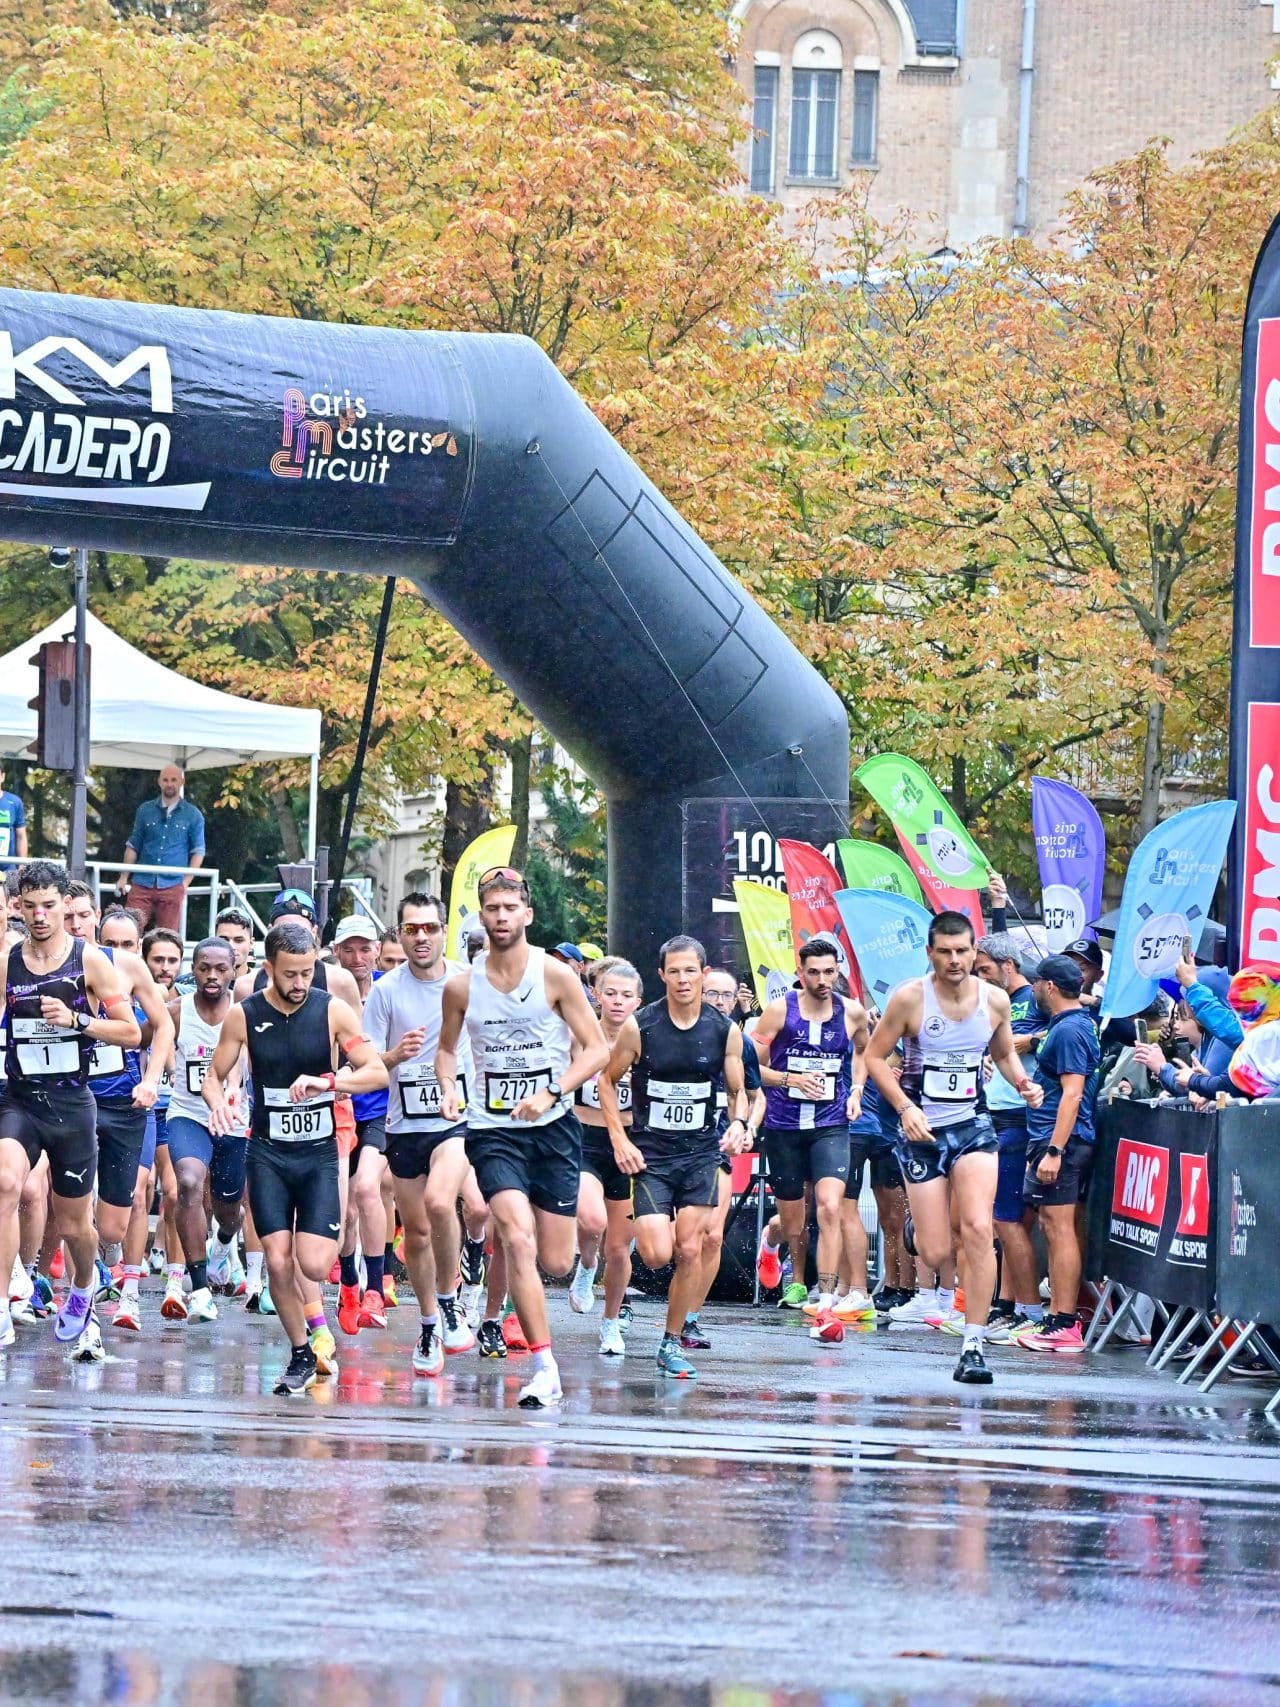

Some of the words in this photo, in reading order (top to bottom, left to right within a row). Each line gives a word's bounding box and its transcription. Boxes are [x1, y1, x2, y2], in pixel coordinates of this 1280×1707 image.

[43, 1046, 49, 1066] 1
[513, 1041, 543, 1051] LINES
[500, 1079, 537, 1100] 2727
[948, 1074, 958, 1091] 9
[420, 1086, 442, 1106] 44
[282, 1111, 321, 1134] 5087
[663, 1106, 694, 1123] 406
[1122, 1152, 1160, 1215] RMC
[1125, 1223, 1139, 1241] TALK
[1139, 1228, 1159, 1247] SPORT
